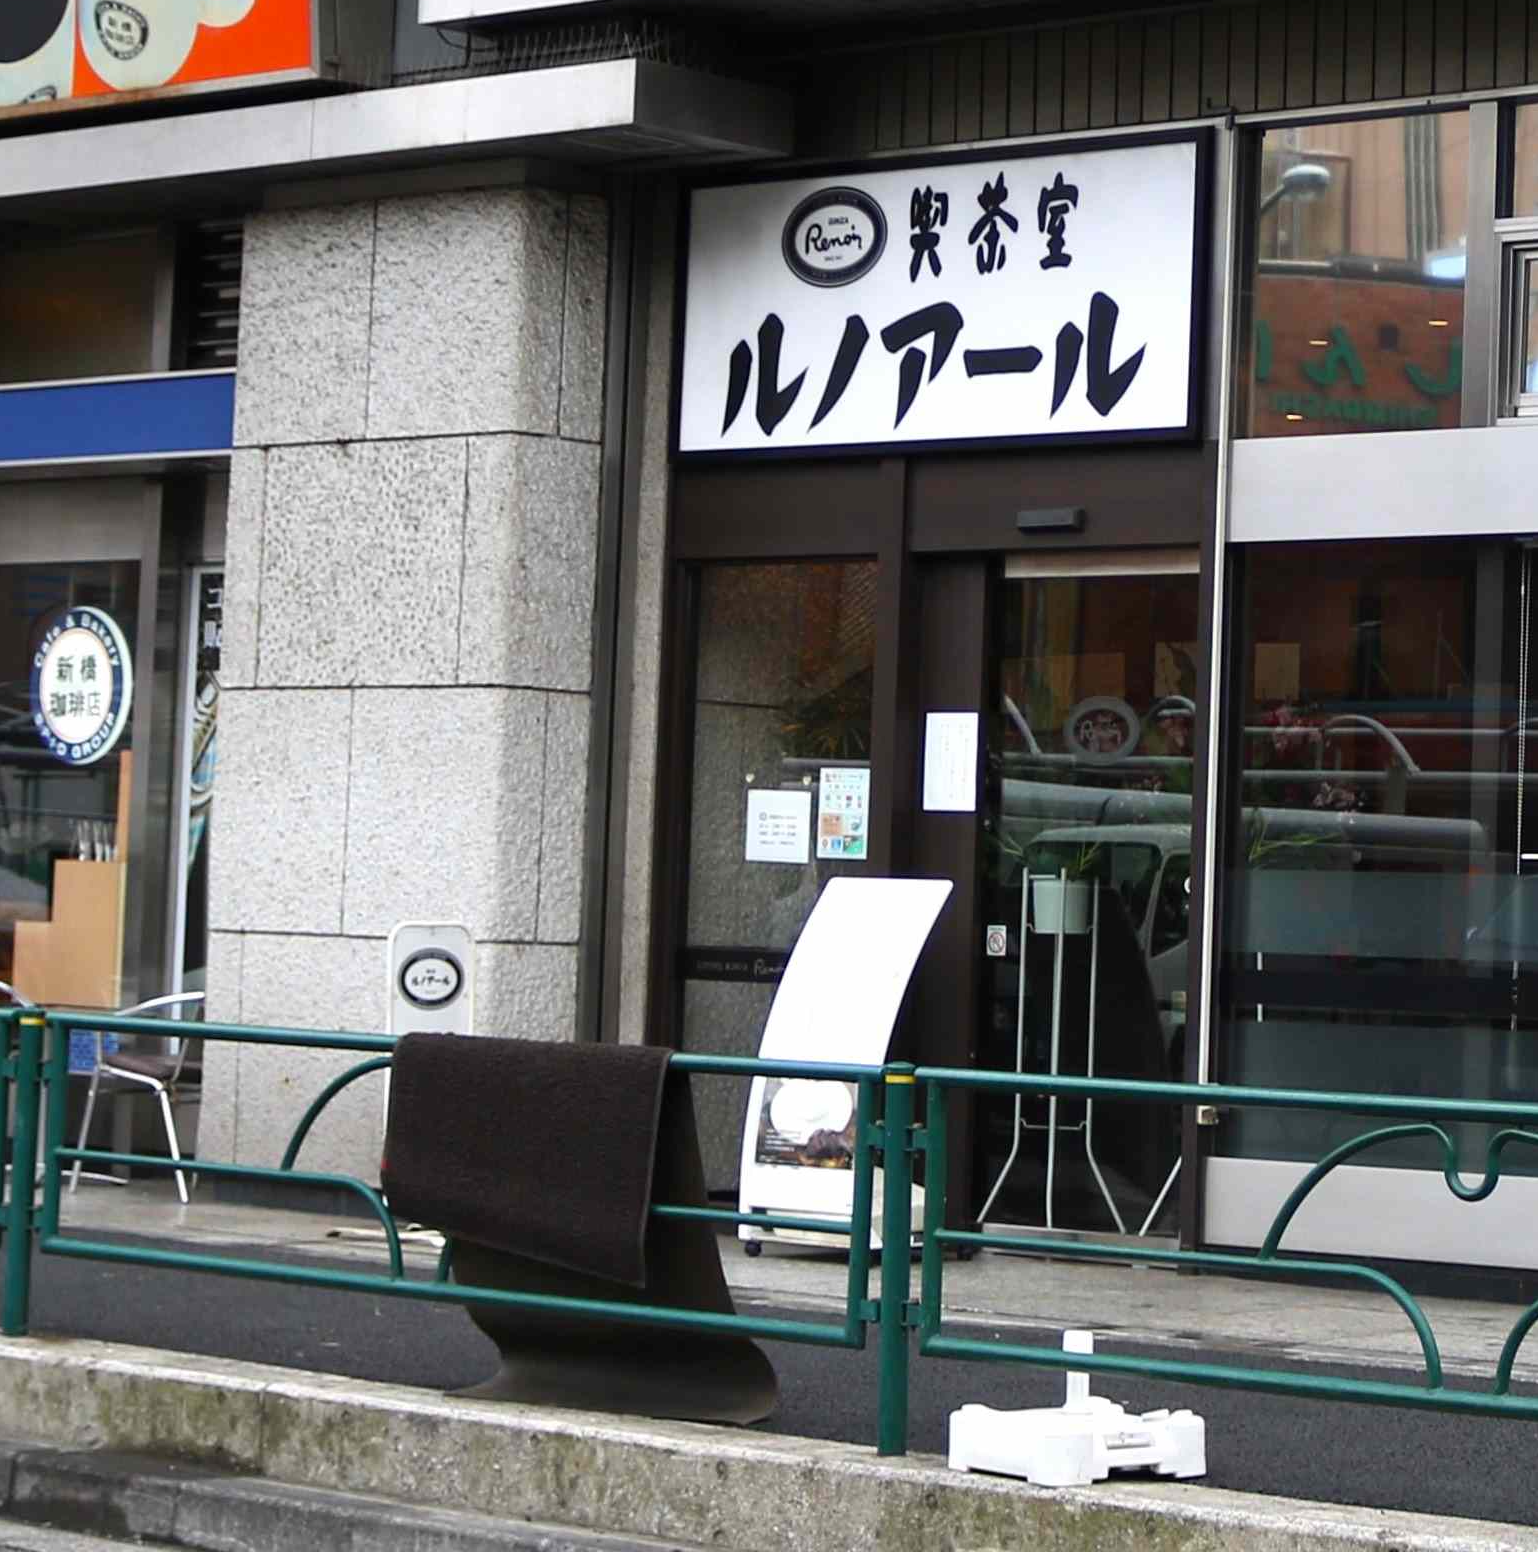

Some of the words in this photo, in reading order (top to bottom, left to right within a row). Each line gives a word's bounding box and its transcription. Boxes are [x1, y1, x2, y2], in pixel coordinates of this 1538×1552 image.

[804, 223, 863, 256] Renoir
[909, 171, 1079, 283] 喫茶室
[721, 290, 1148, 439] ルノアール
[56, 654, 97, 683] 新橋
[49, 689, 102, 718] 珈琲店
